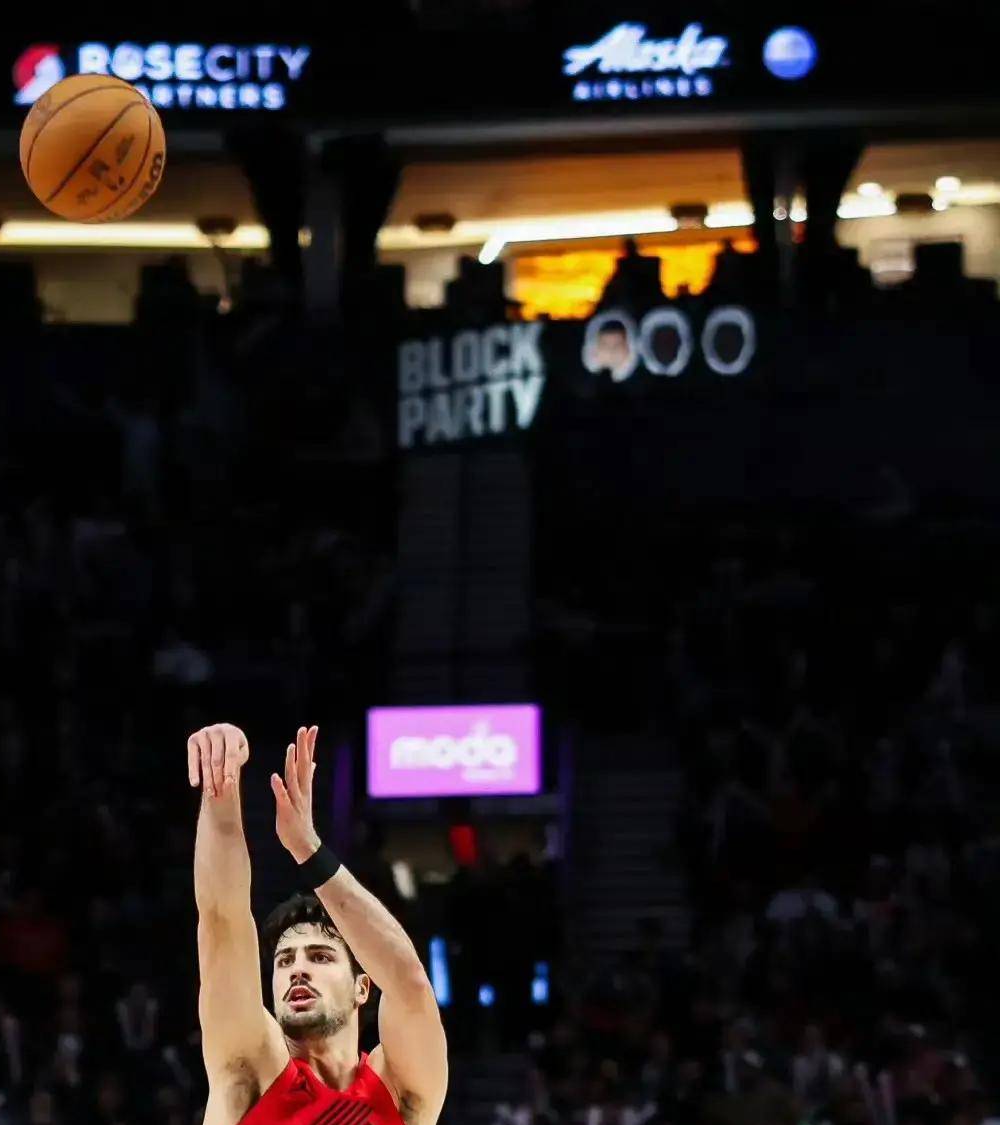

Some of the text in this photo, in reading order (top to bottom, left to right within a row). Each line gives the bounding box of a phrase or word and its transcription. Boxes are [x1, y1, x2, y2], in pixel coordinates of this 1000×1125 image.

[562, 22, 728, 75] Alaska
[134, 83, 286, 109] RTNERS
[399, 323, 545, 394] BLOCK
[399, 375, 546, 447] PARTY
[389, 720, 517, 770] moda
